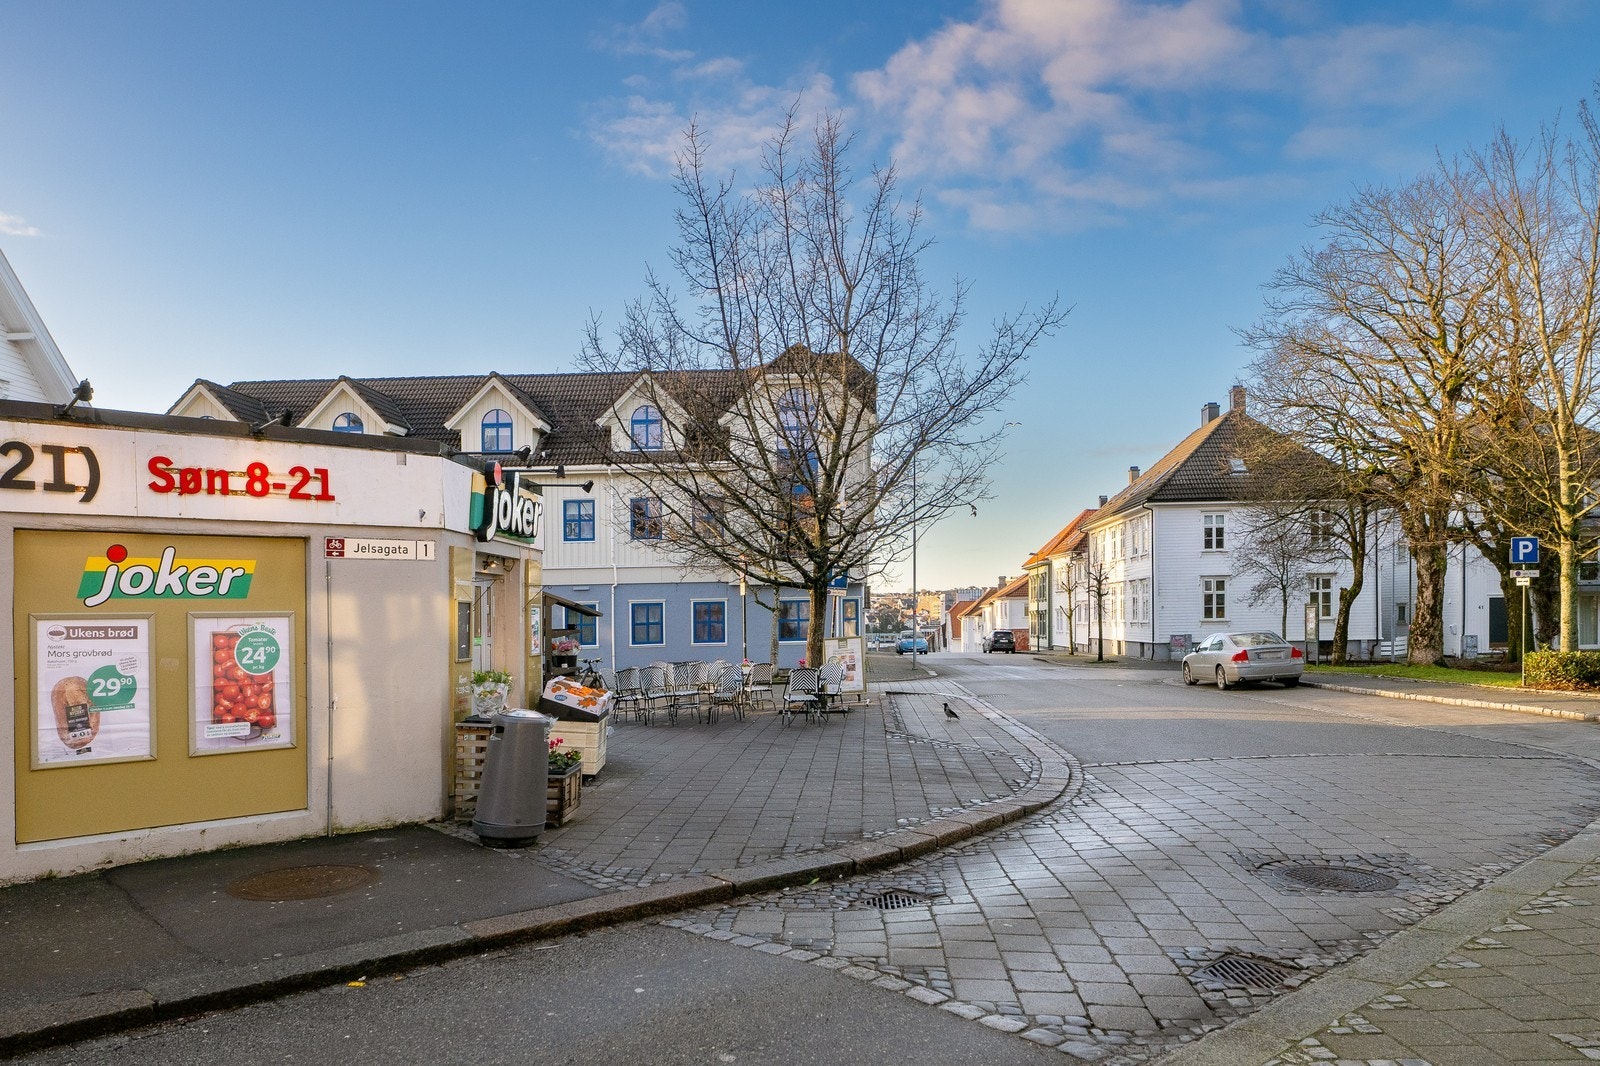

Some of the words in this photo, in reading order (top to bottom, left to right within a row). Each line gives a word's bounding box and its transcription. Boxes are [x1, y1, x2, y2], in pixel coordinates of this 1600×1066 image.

[147, 456, 230, 496] Søn
[245, 461, 336, 502] 8-21
[477, 461, 544, 543] joker
[353, 543, 409, 556] Jelsagata
[423, 543, 428, 557] 1
[1518, 540, 1533, 561] P
[83, 543, 246, 608] joker
[69, 627, 105, 638] Ukens
[107, 627, 134, 638] brød
[47, 650, 71, 658] Mors
[72, 649, 113, 659] grovbrød
